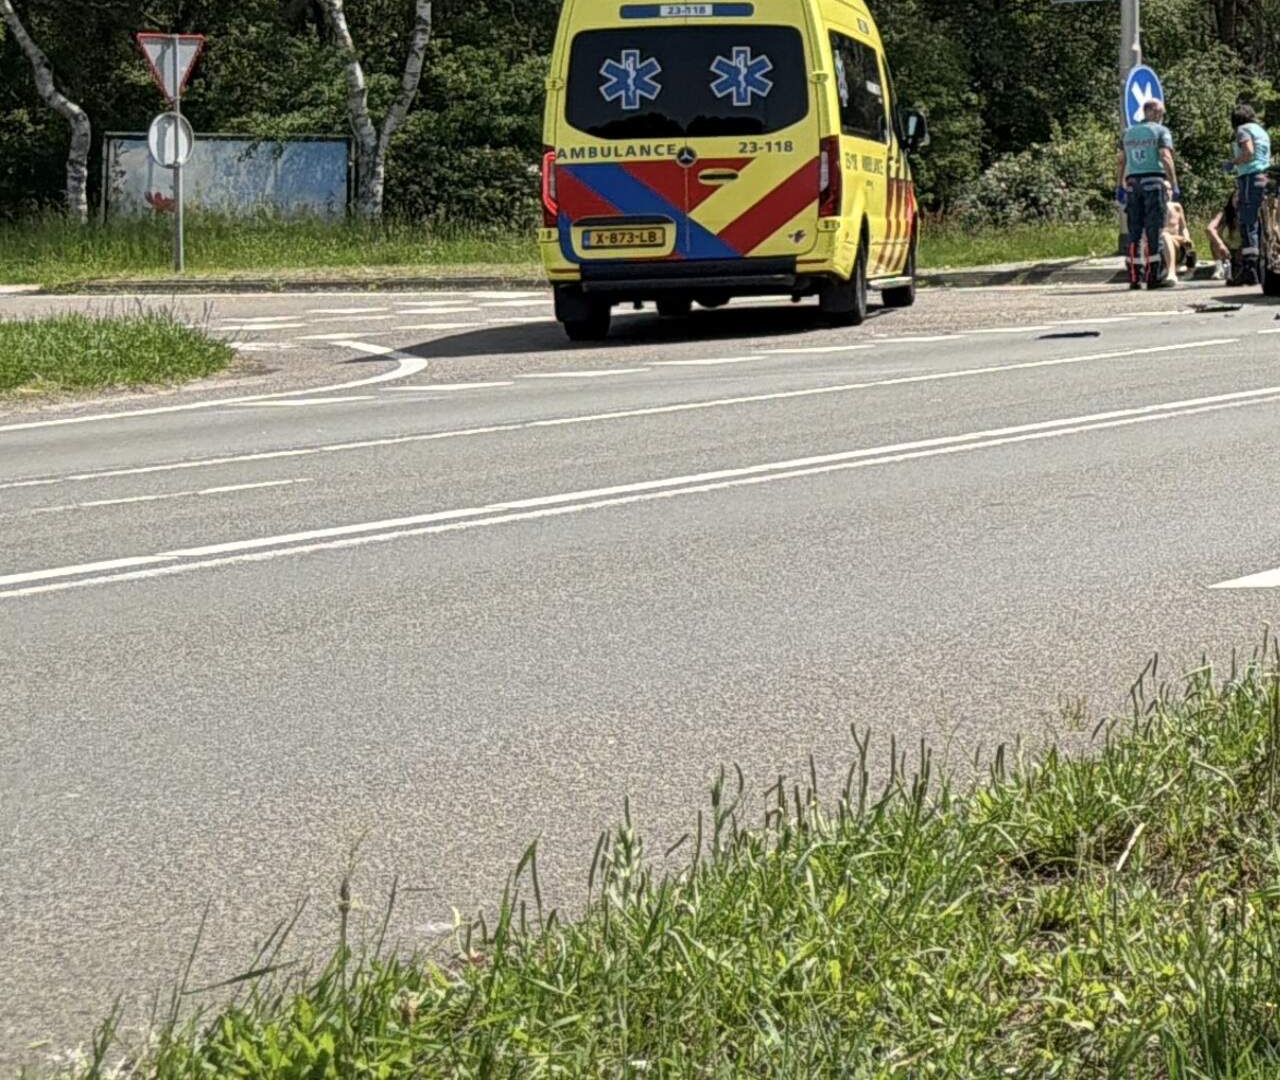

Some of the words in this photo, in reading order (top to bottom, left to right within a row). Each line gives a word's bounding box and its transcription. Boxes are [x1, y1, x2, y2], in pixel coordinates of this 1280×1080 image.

[557, 143, 678, 160] AMBULANCE
[738, 140, 794, 154] 23-118
[595, 231, 657, 245] X-873-LB
